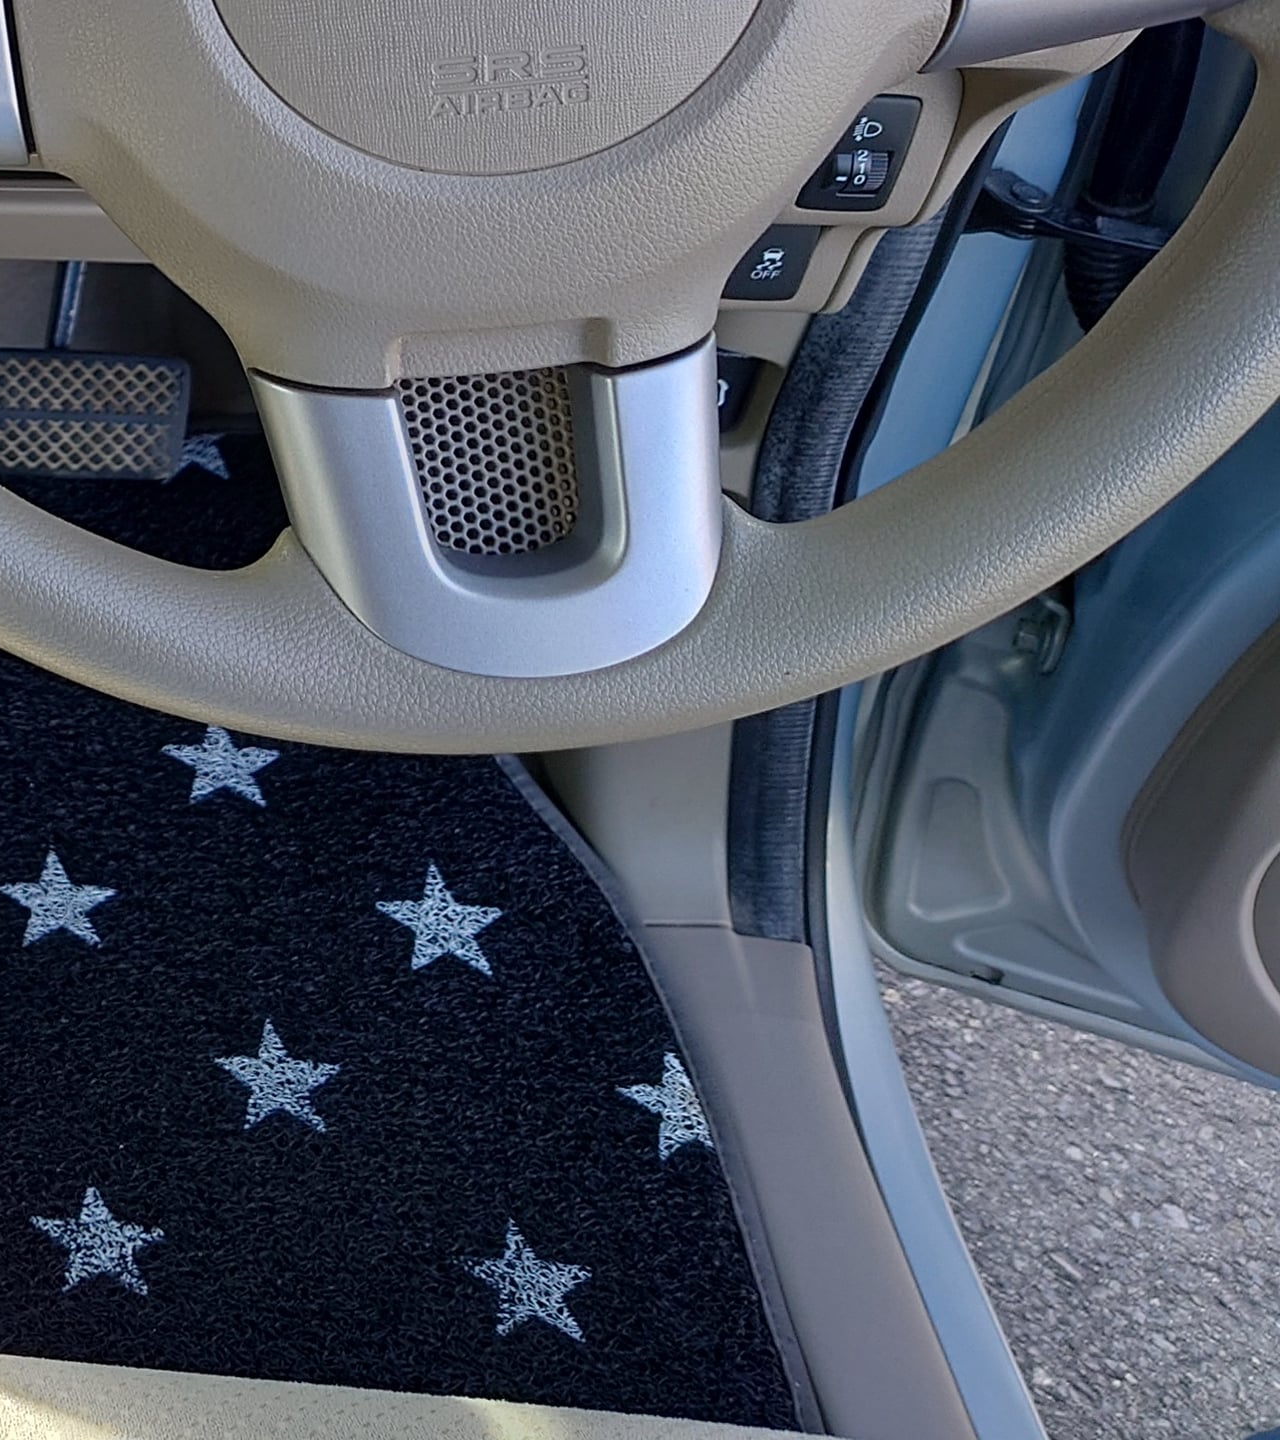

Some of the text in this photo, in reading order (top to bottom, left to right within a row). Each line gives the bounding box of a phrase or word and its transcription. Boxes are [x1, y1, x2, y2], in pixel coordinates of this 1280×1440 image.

[433, 44, 586, 86] SRS
[428, 81, 590, 120] AIRBAG
[857, 149, 869, 161] 2
[853, 174, 866, 185] 0
[750, 269, 781, 281] OFF
